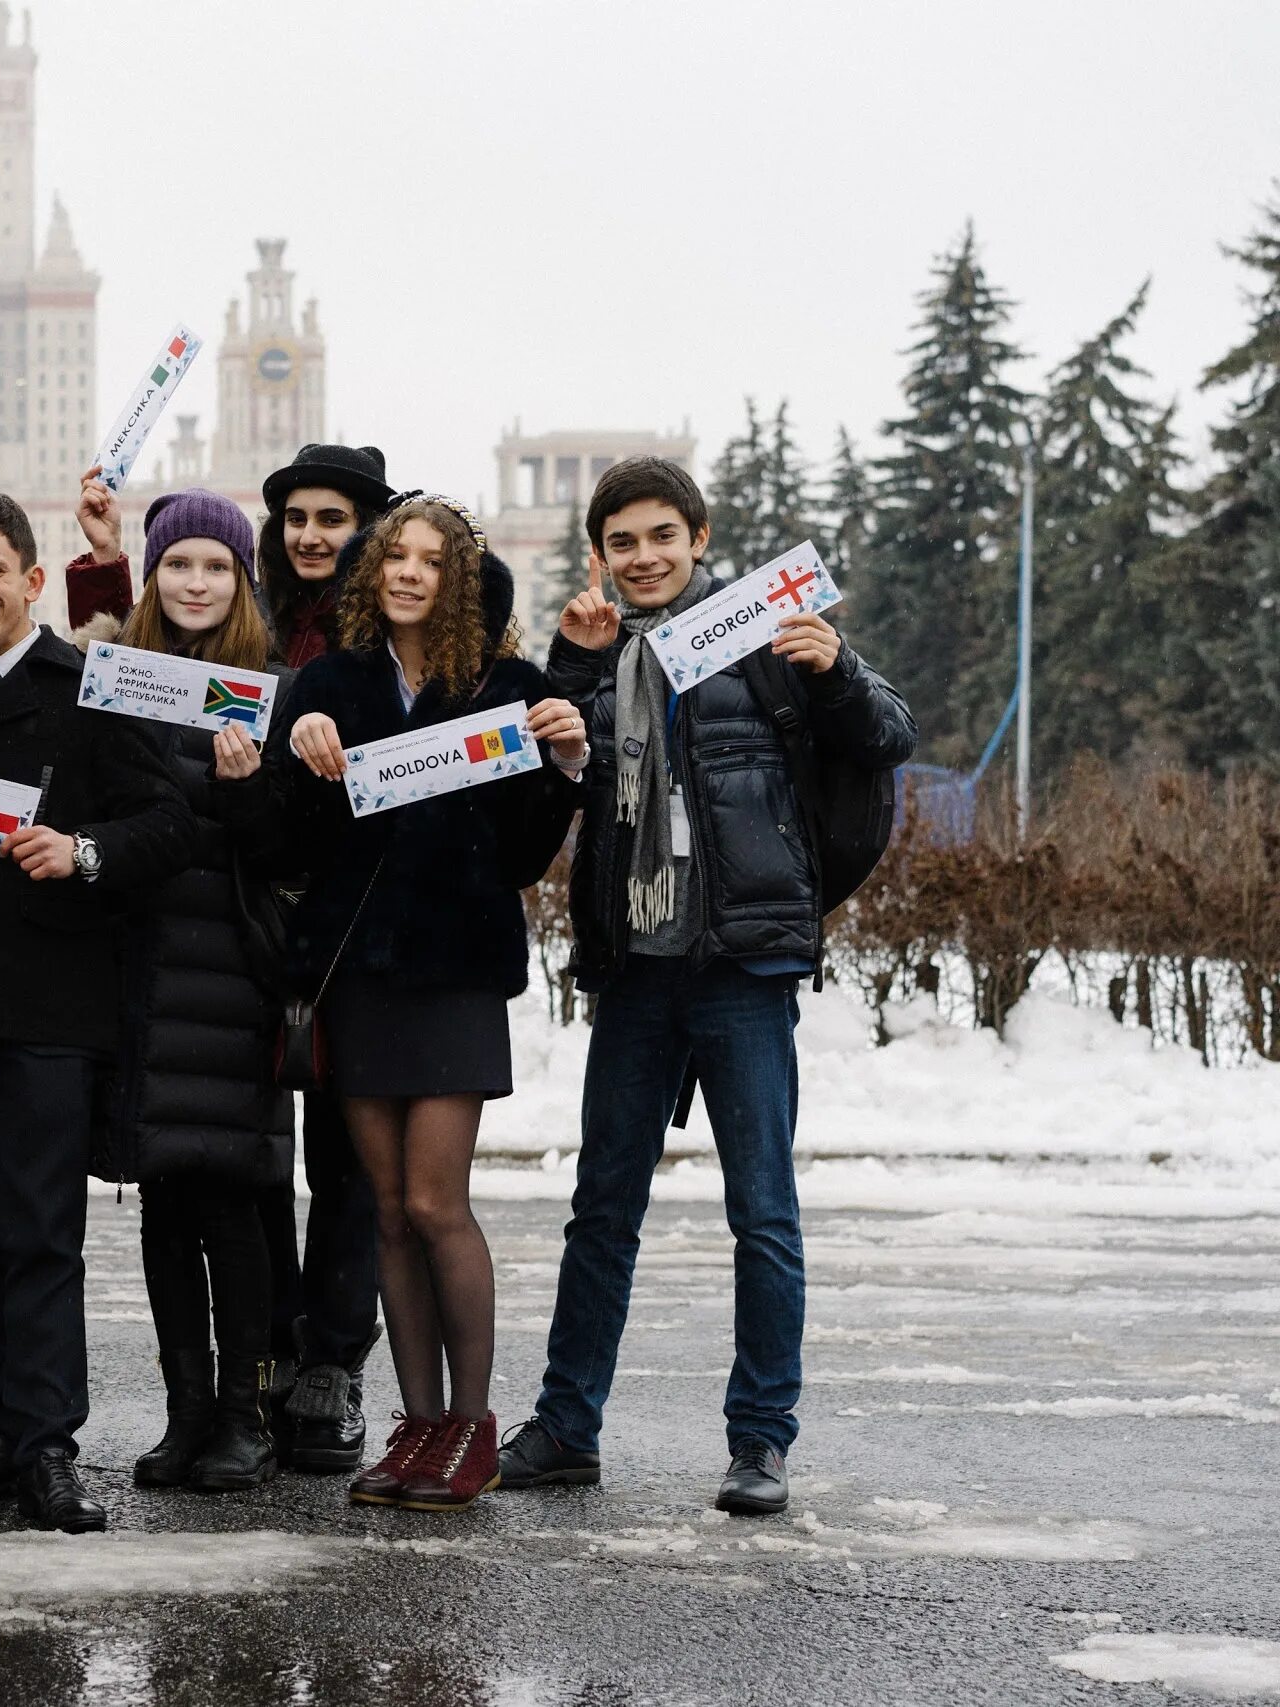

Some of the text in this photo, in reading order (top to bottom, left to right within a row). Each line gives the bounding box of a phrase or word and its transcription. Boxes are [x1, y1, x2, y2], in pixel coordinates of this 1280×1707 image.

[110, 388, 155, 457] МЕКСИКА
[690, 600, 768, 651] GEORGIA
[118, 665, 157, 679] ЮЖНО-
[114, 687, 176, 706] РЕСПУБЛИКА
[115, 676, 189, 697] АФРИКАНСКАЯ
[379, 749, 464, 783] MOLDOVA
